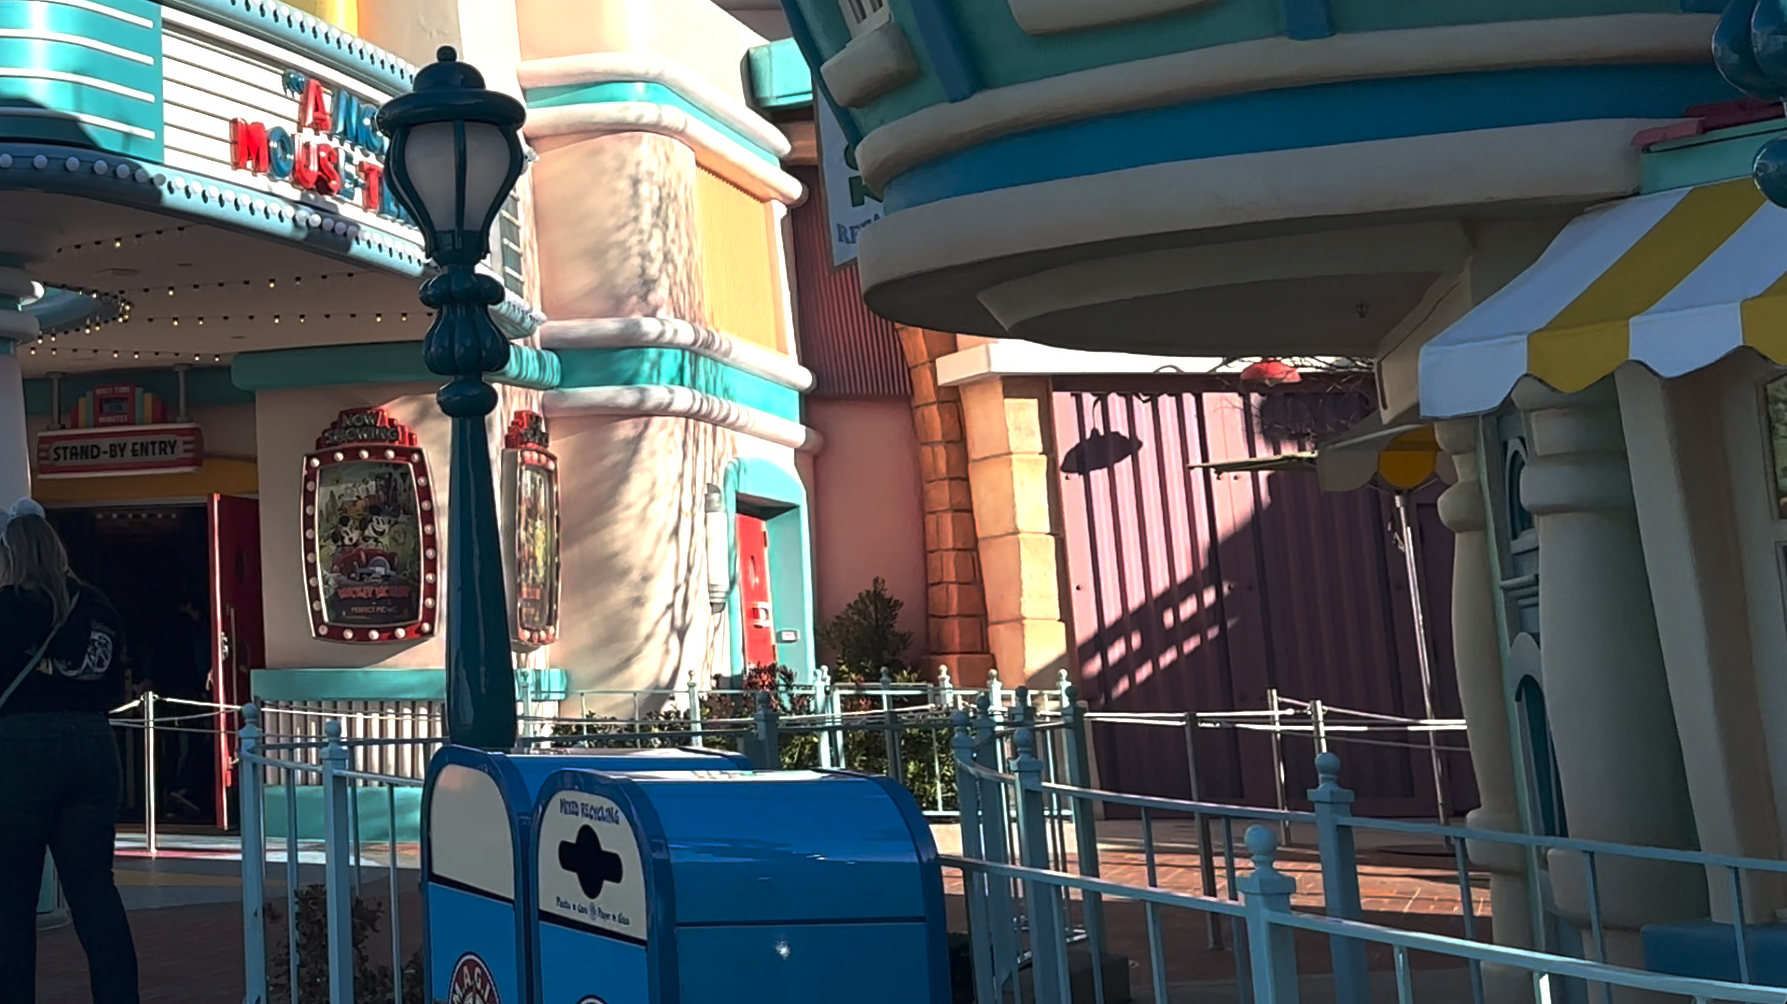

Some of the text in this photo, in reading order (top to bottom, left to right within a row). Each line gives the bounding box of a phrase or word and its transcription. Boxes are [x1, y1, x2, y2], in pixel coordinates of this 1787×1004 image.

[342, 413, 376, 427] NOW
[53, 439, 178, 461] STAND-BY ENTRY
[580, 802, 619, 825] RECYCLING
